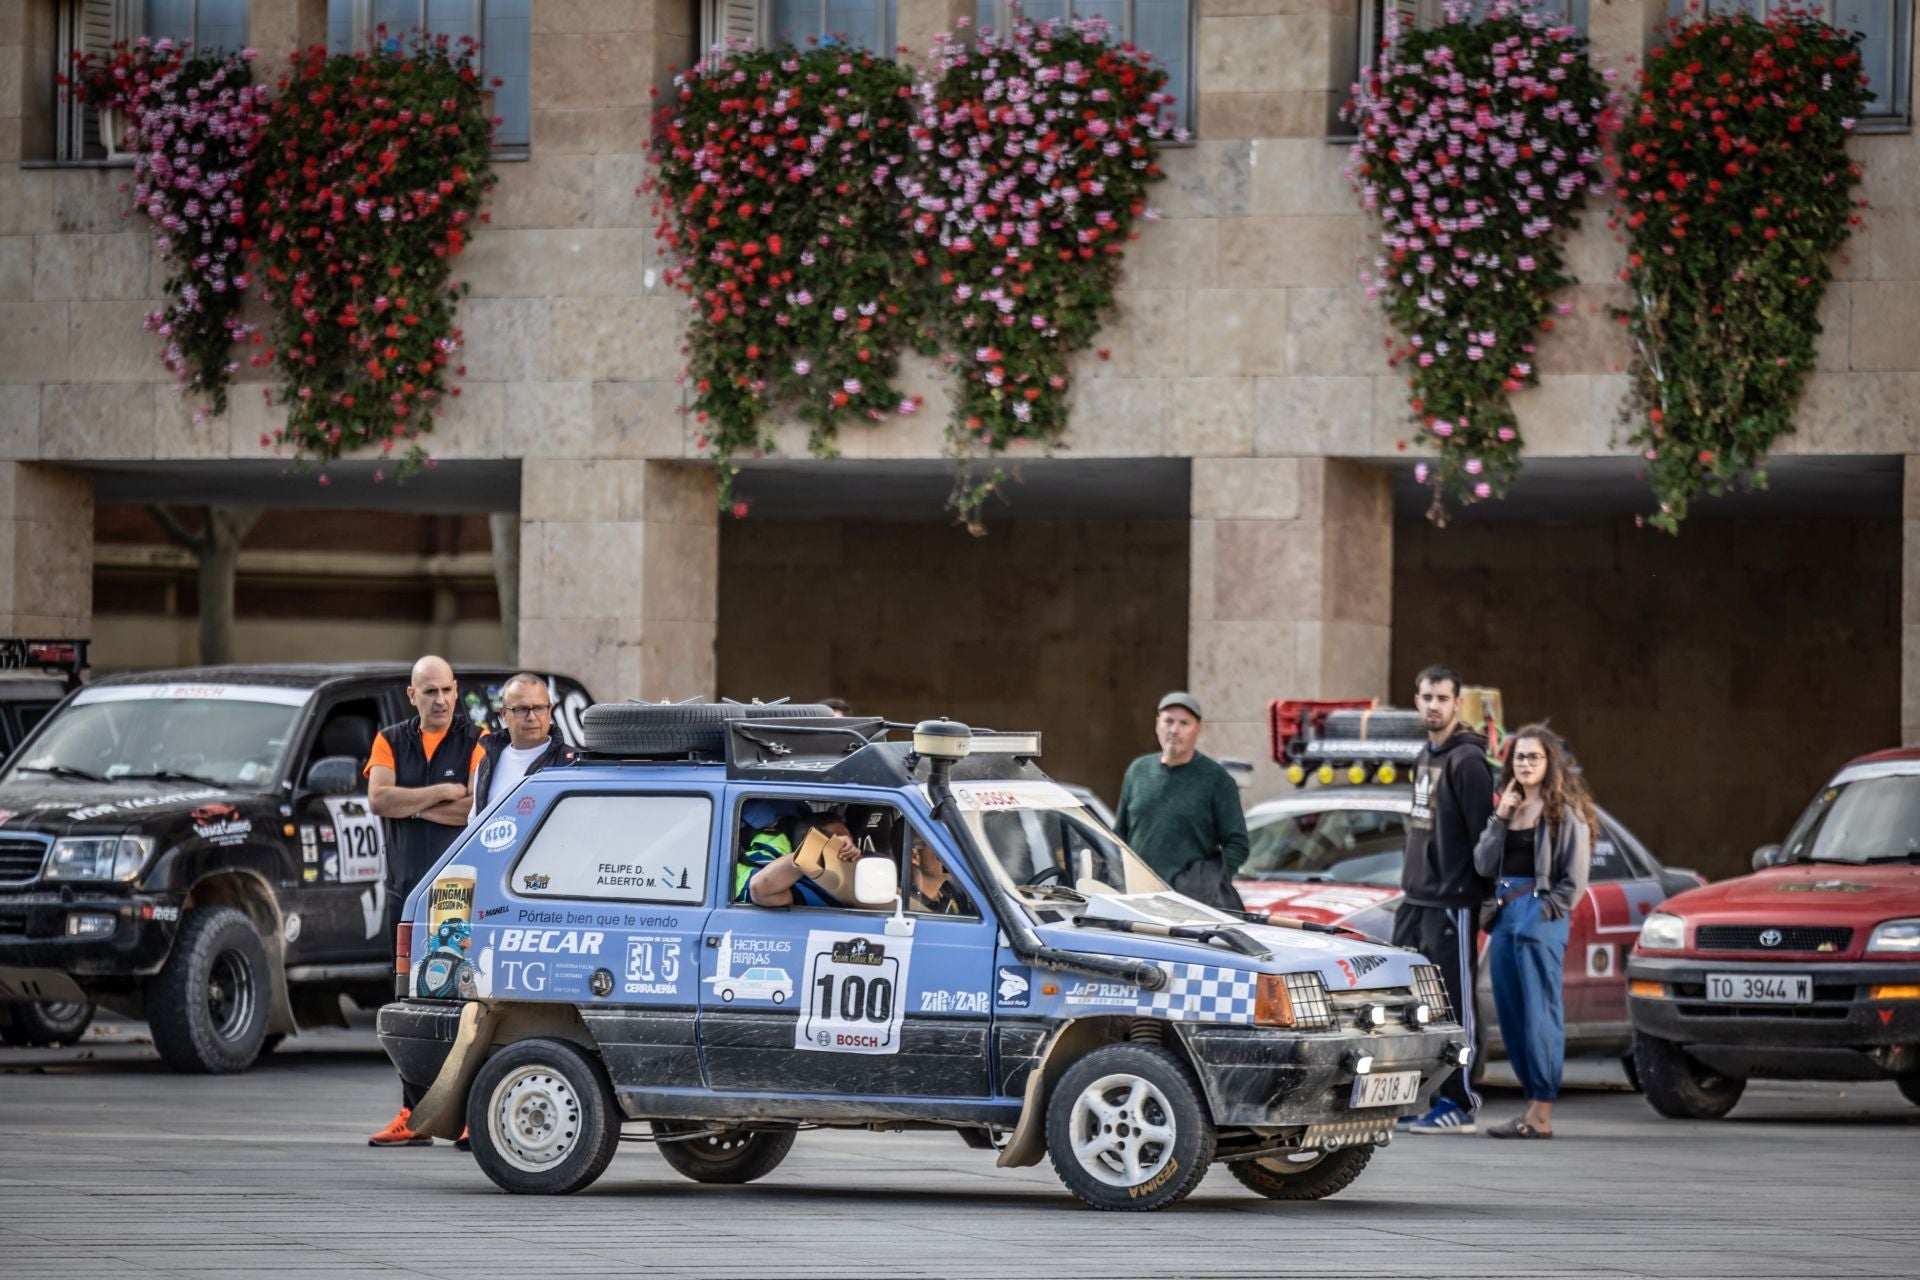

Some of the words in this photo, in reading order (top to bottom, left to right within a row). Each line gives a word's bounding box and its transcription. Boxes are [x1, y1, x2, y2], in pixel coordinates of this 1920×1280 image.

[342, 825, 378, 859] 120
[485, 822, 513, 843] KEOS
[598, 863, 633, 874] FELIPE
[597, 876, 644, 887] ALBERTO
[429, 888, 475, 908] WINGMAN
[153, 906, 179, 921] RRS
[518, 909, 563, 924] Pórtate
[566, 912, 593, 925] bien
[594, 914, 621, 930] que
[624, 914, 636, 926] te
[639, 915, 679, 928] vendo
[498, 929, 605, 955] BECAR
[733, 939, 791, 952] HERCULES
[732, 953, 771, 965] BIRRAS
[501, 960, 547, 992] TG
[817, 974, 892, 1023] 100
[1099, 983, 1140, 998] RENT
[1711, 979, 1733, 999] TO
[1743, 979, 1786, 999] 3944
[1797, 979, 1808, 1000] W
[836, 1034, 878, 1047] BOSCH
[1358, 1077, 1368, 1103] M
[1371, 1075, 1400, 1102] 7318
[1403, 1075, 1420, 1100] JY
[1129, 1157, 1178, 1199] FEDIMA
